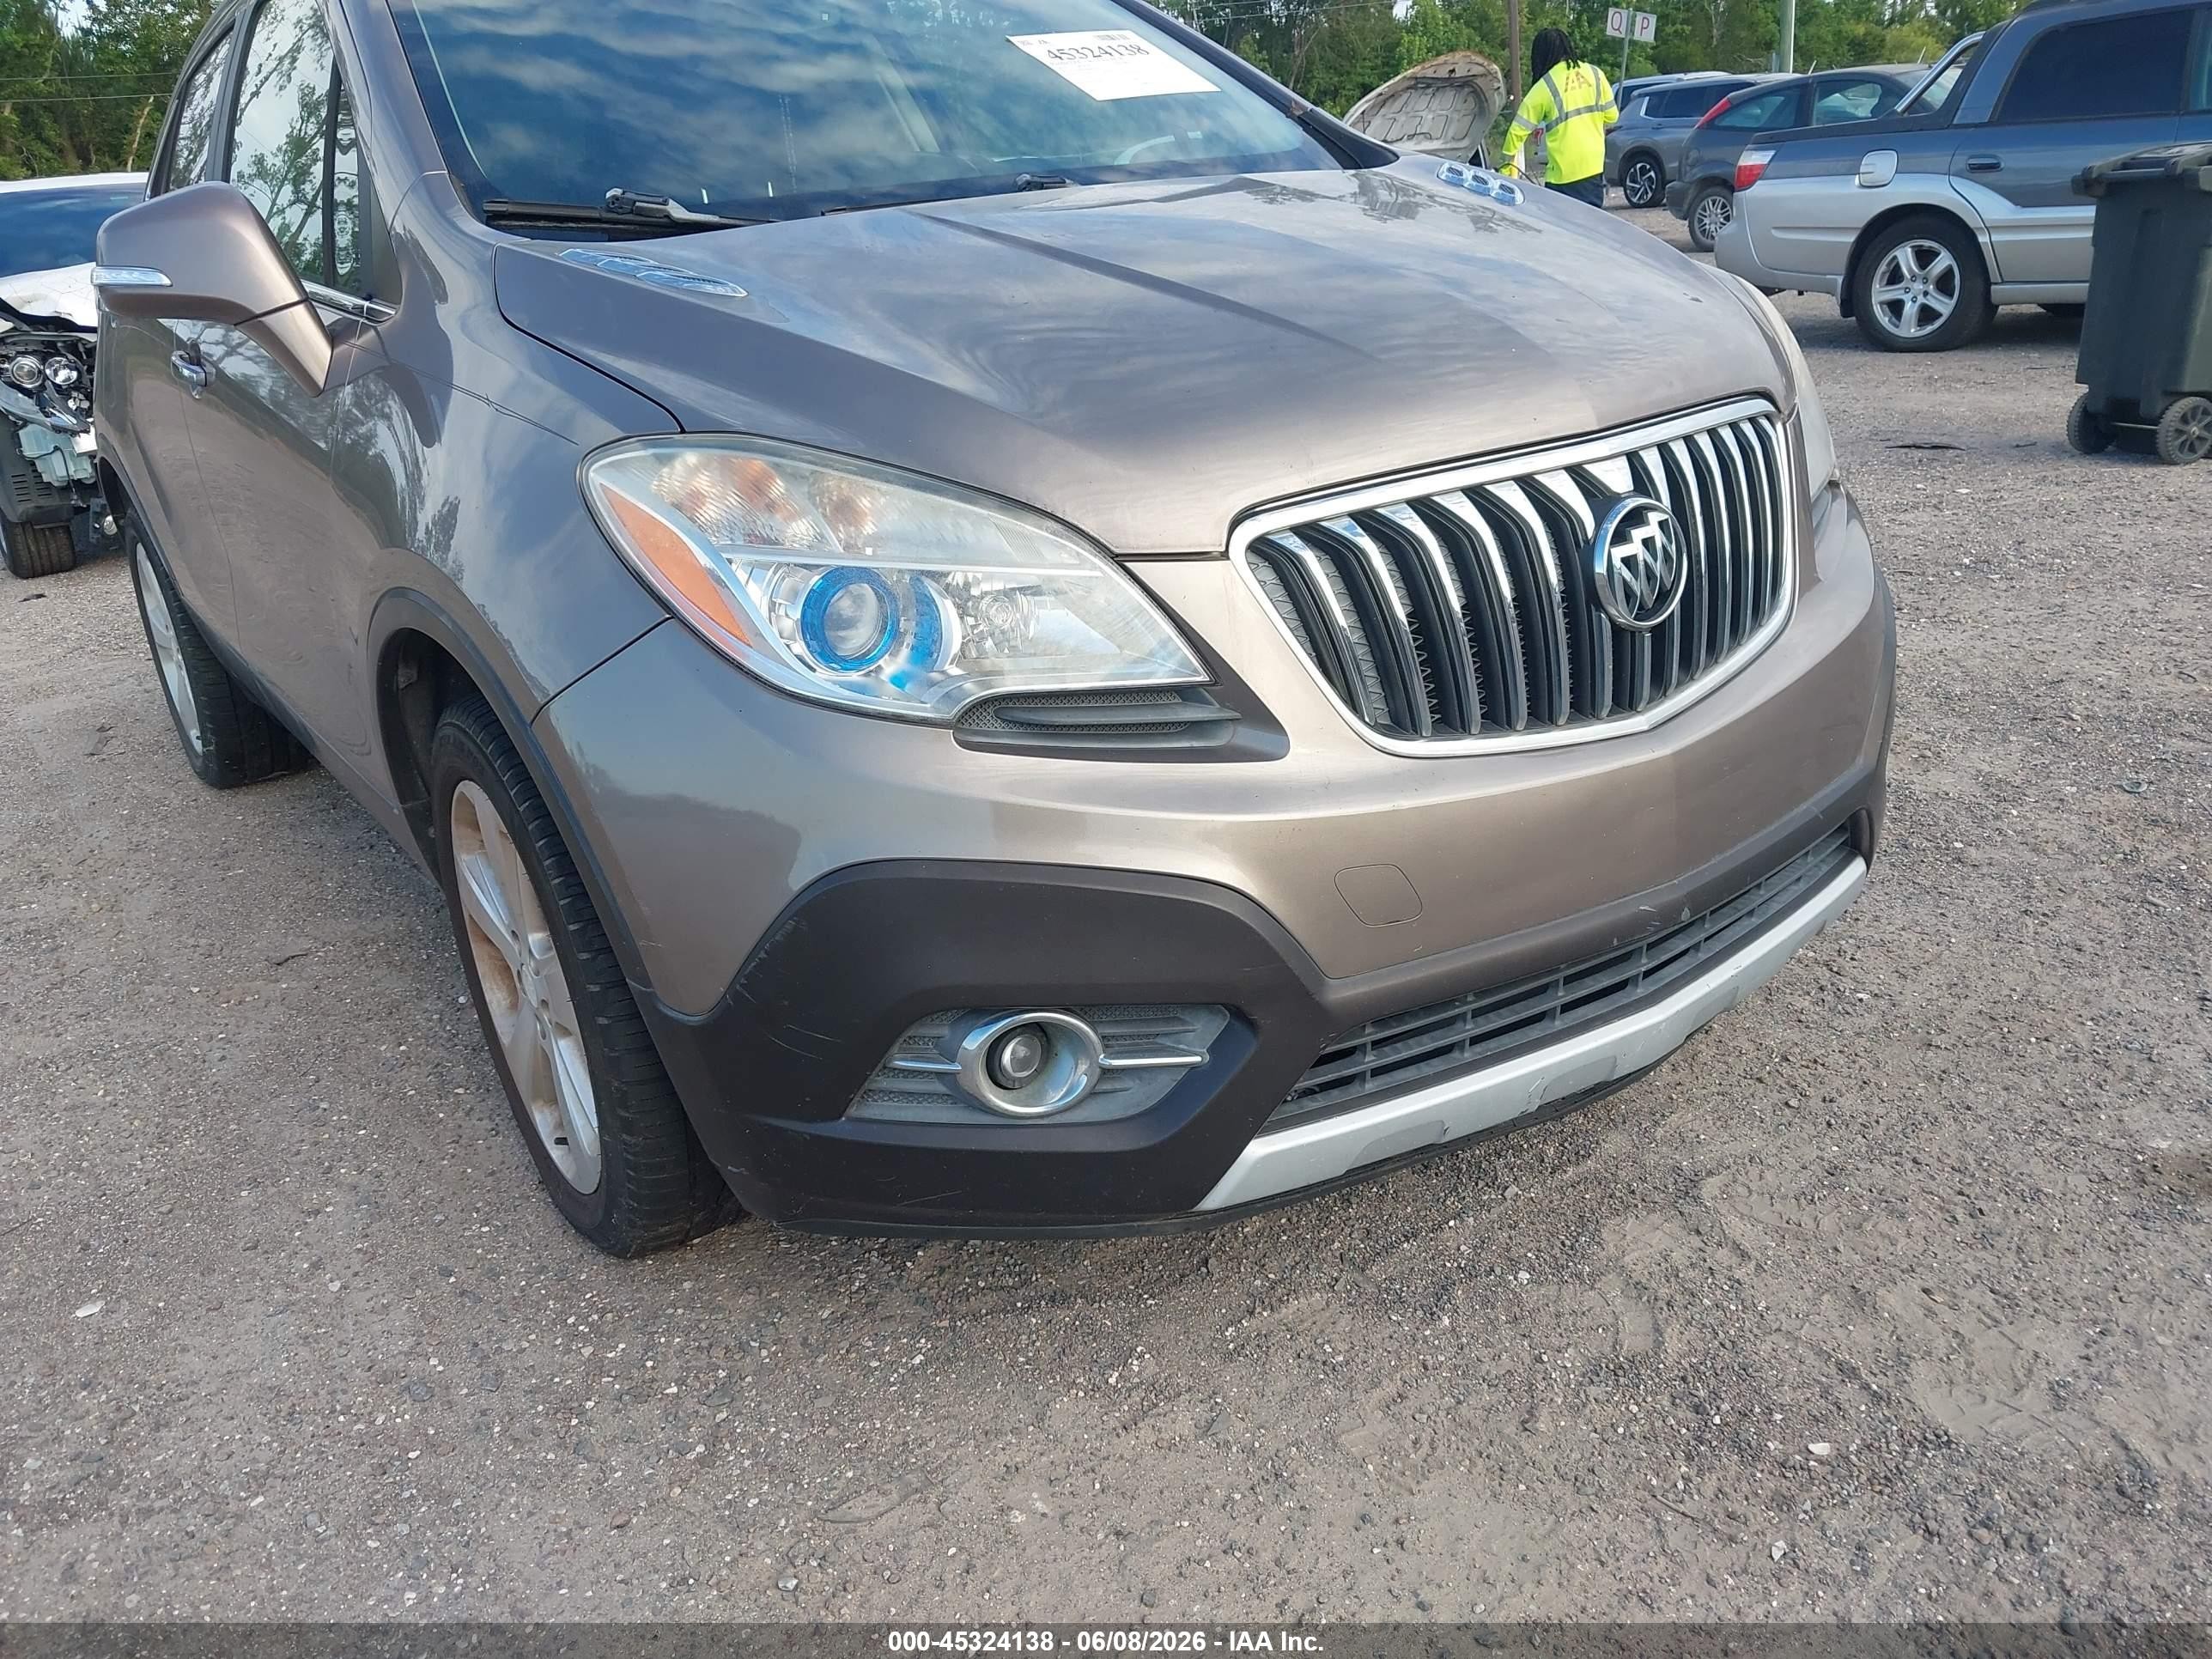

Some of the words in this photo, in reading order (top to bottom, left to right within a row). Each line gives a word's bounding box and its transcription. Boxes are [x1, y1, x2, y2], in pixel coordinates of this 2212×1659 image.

[1611, 11, 1623, 34] Q
[1640, 16, 1650, 36] P
[1047, 44, 1151, 61] 45324138
